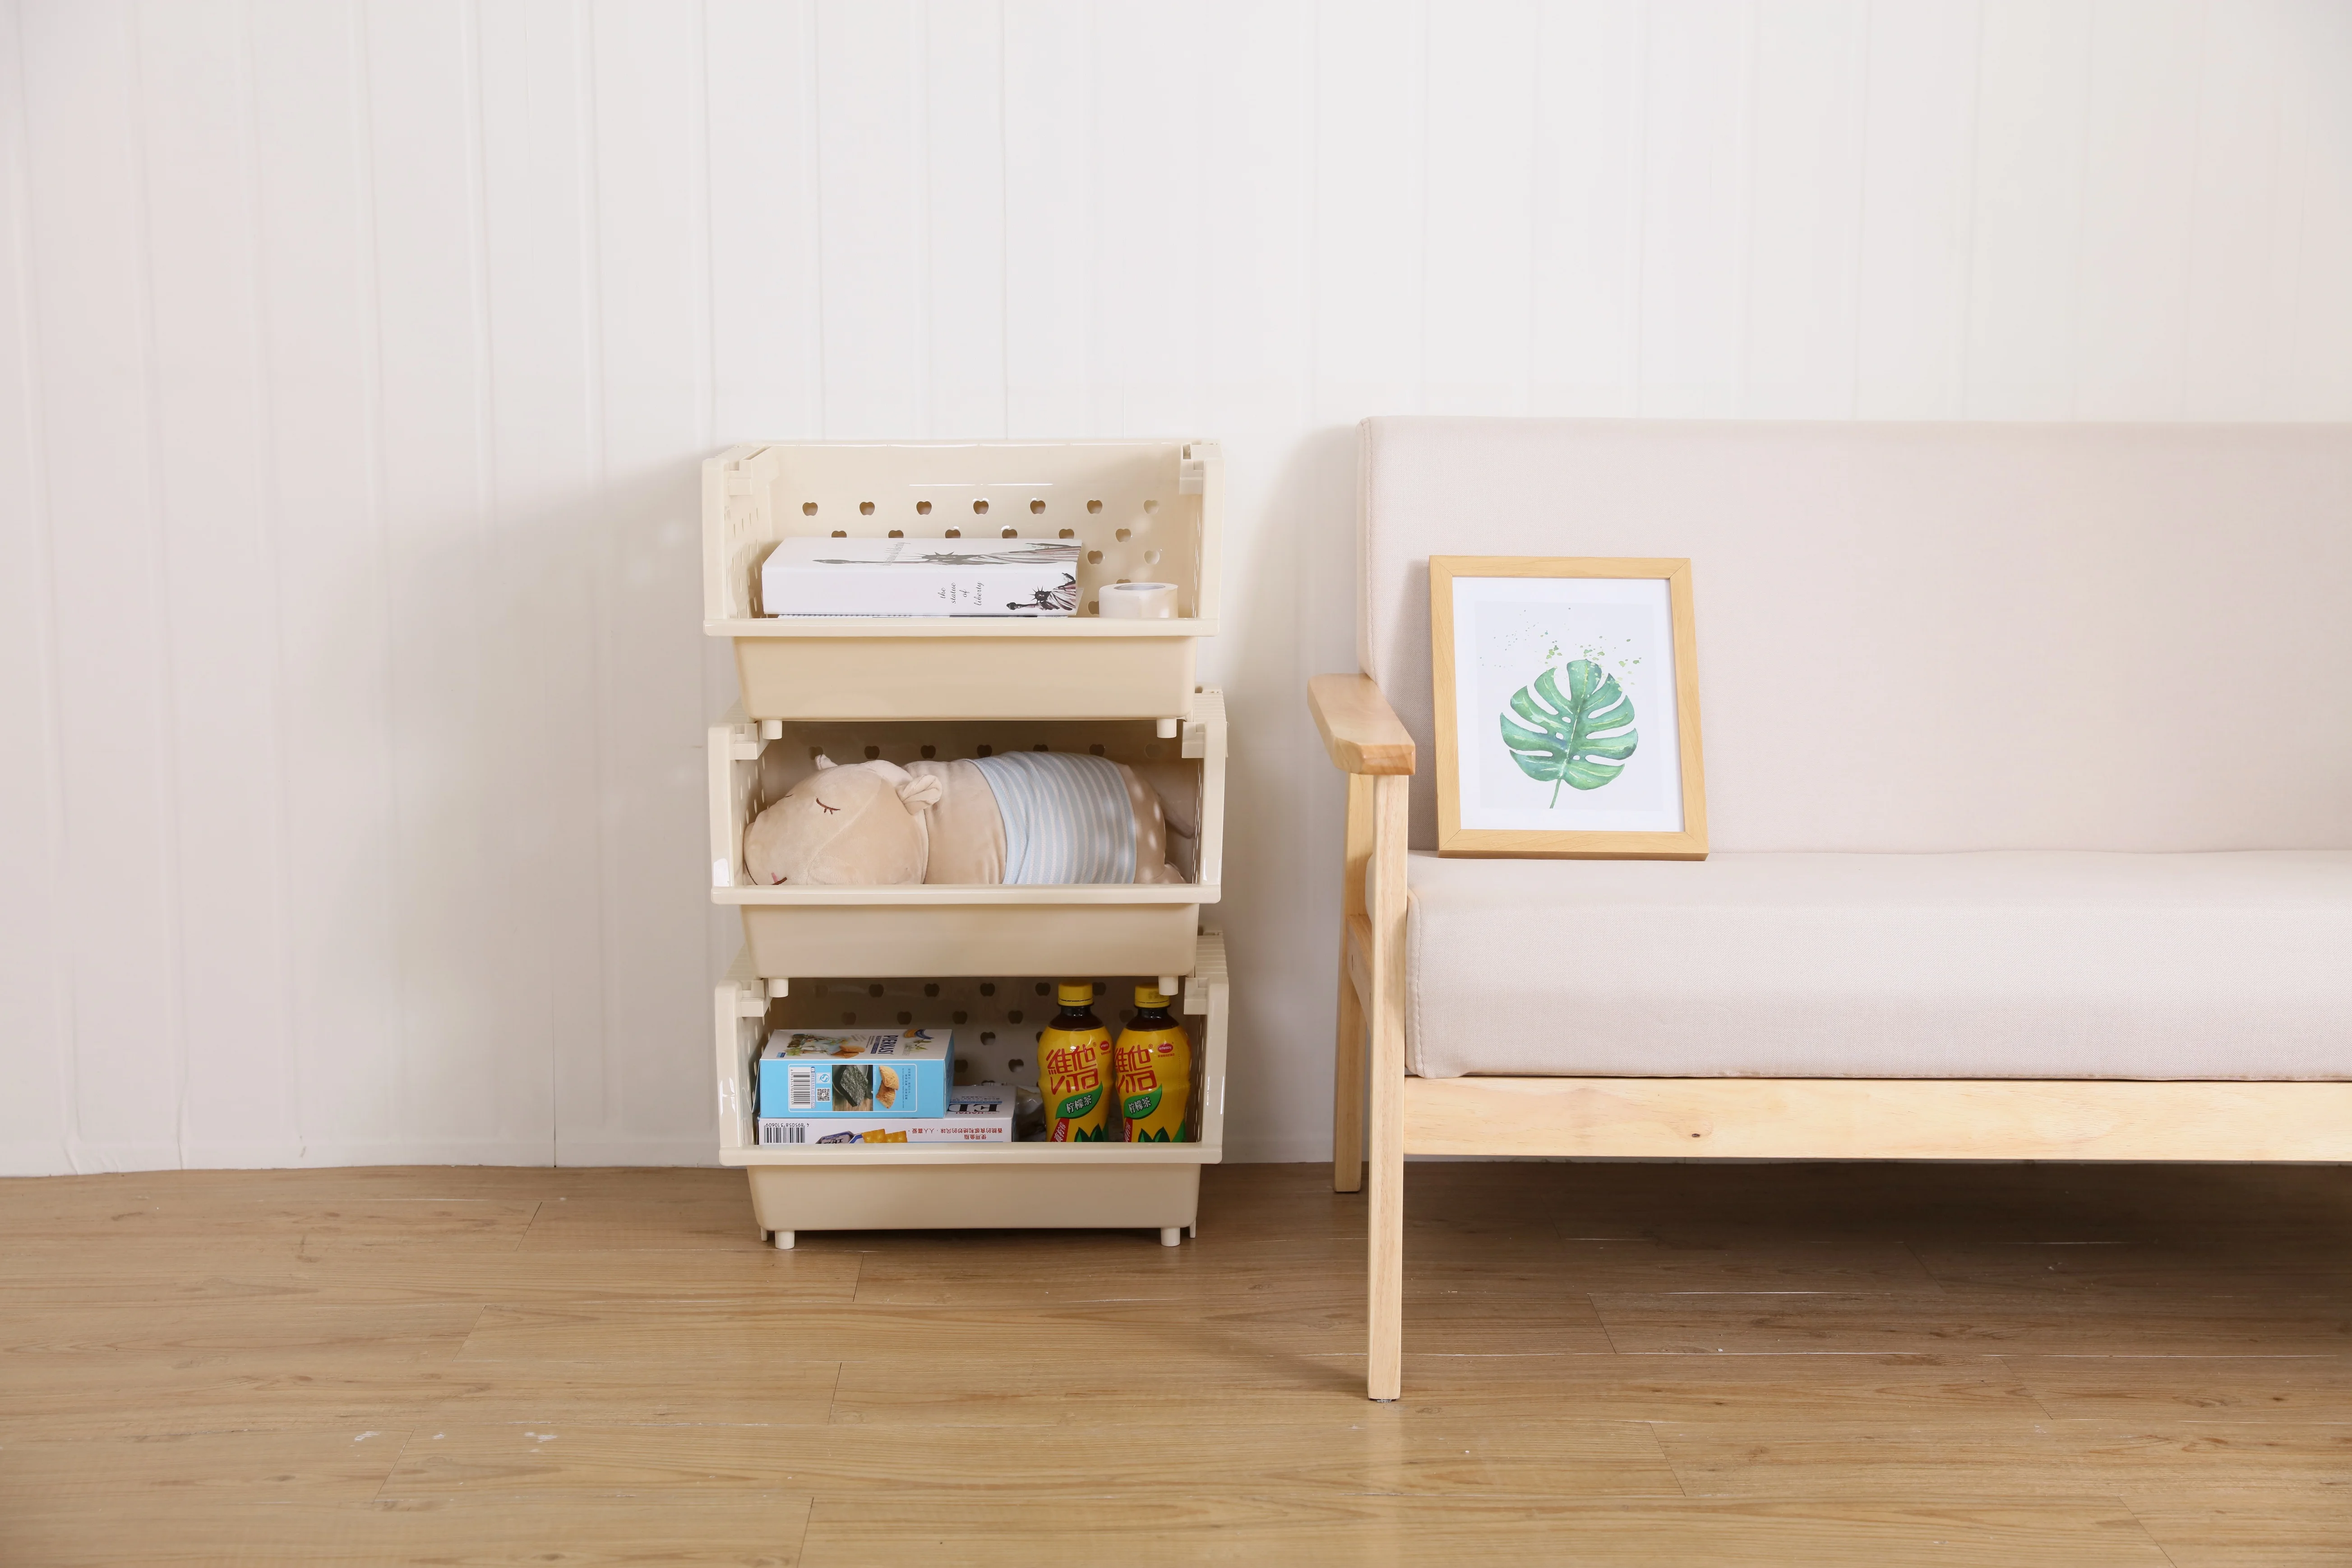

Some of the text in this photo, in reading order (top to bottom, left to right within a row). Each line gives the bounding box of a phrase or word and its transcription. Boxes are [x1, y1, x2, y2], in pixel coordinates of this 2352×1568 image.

[938, 587, 946, 599] the
[959, 589, 970, 598] of
[974, 581, 984, 606] liberty
[878, 1035, 899, 1054] PIERKASI
[1066, 1095, 1093, 1114] 柠檬茶
[1128, 1097, 1151, 1114] 柠檬茶
[1052, 1121, 1066, 1142] 真柠檬
